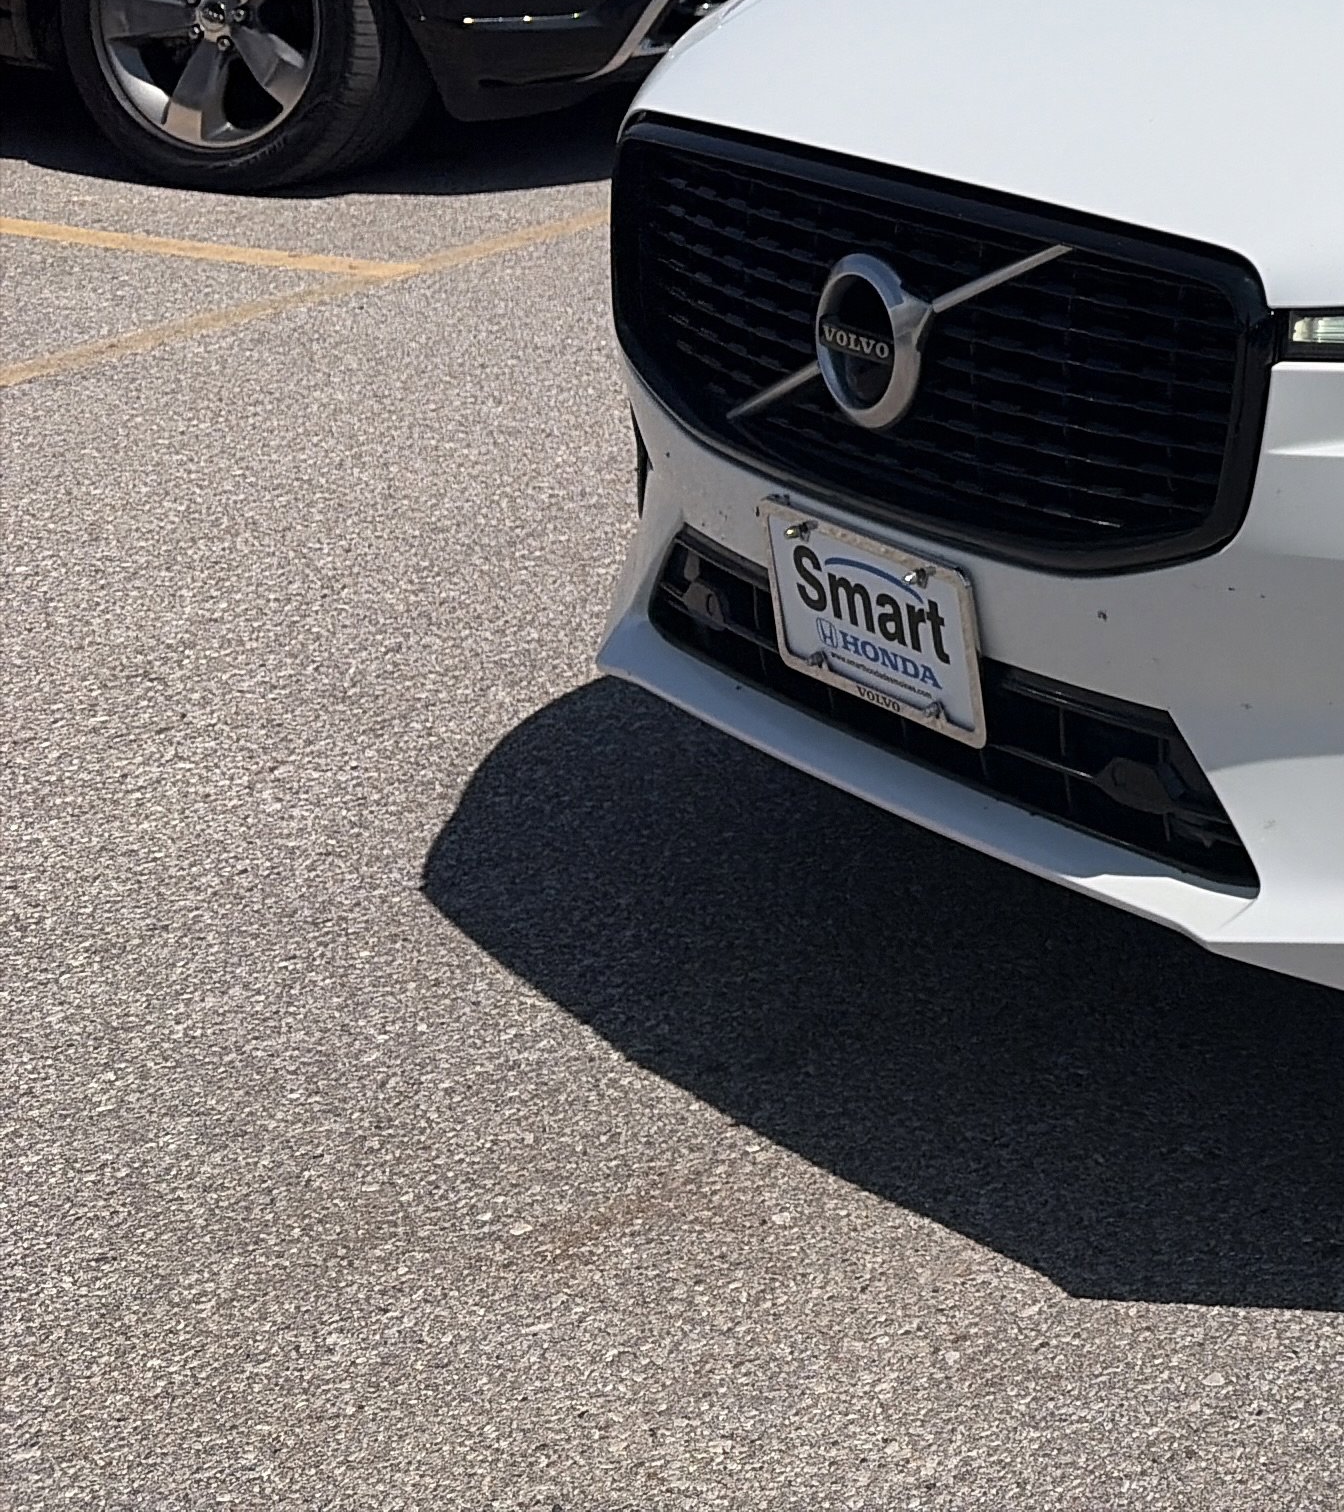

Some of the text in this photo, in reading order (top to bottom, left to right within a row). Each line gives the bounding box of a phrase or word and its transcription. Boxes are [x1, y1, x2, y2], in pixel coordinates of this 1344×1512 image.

[822, 324, 890, 359] VOLVO
[792, 544, 950, 665] Smart
[839, 630, 943, 690] HONDA
[856, 684, 901, 713] VOLVO
